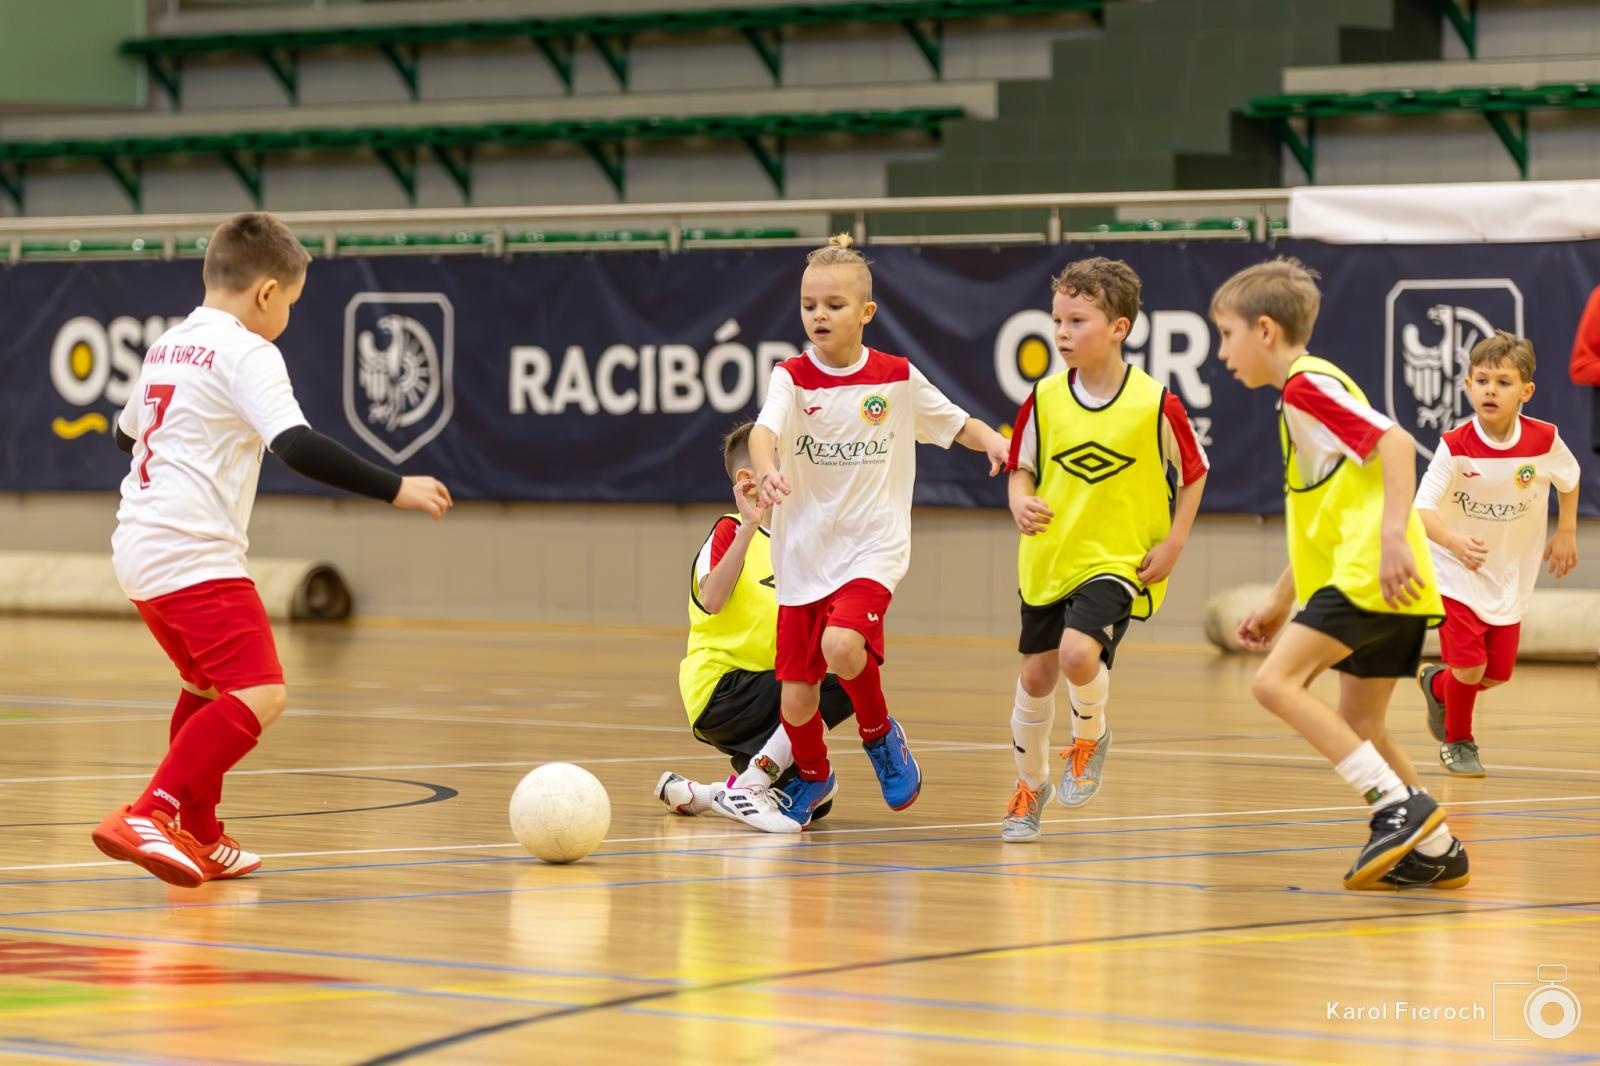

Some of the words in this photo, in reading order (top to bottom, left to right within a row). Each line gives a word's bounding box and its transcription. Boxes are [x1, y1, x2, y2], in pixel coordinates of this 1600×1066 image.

[49, 315, 187, 407] OS
[144, 345, 168, 365] NIA
[170, 344, 216, 369] TURZA
[508, 317, 812, 415] RACIBÓR
[994, 309, 1213, 409] OR
[138, 383, 177, 490] 7
[795, 434, 888, 465] REKPOL
